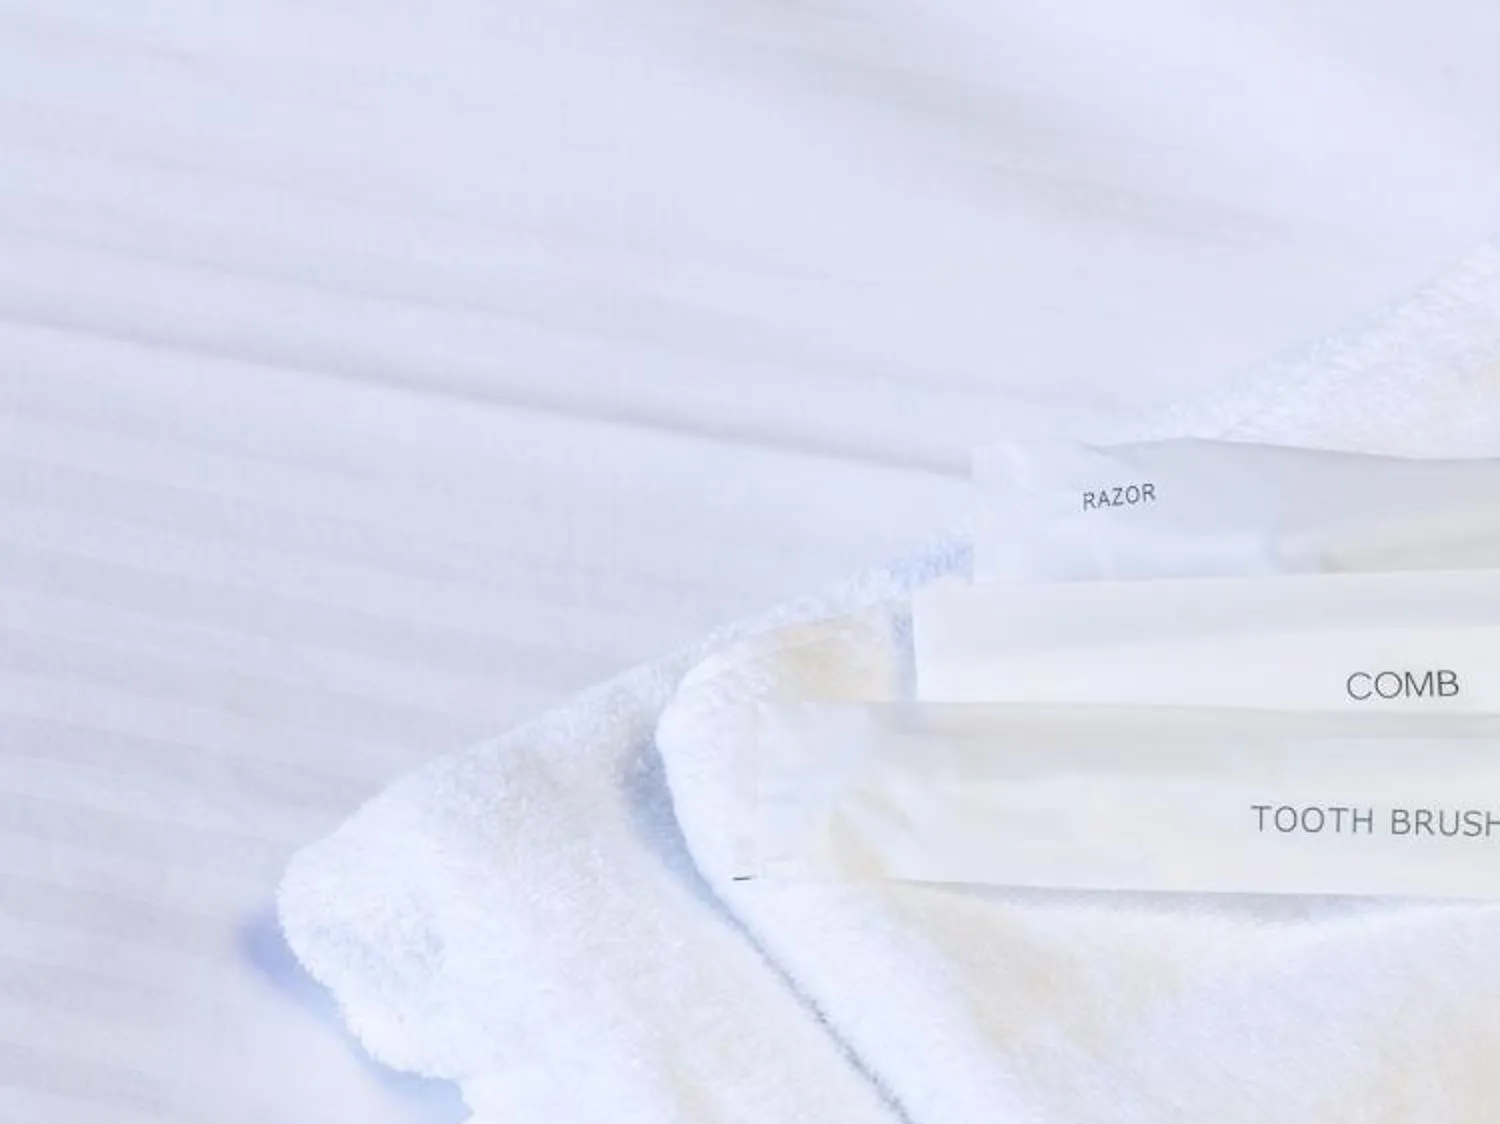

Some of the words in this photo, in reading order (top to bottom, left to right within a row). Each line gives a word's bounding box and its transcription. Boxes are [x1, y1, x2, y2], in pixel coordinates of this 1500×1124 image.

[1082, 482, 1157, 512] RAZOR
[1346, 669, 1460, 701] COMB
[1250, 804, 1374, 835] TOOTH
